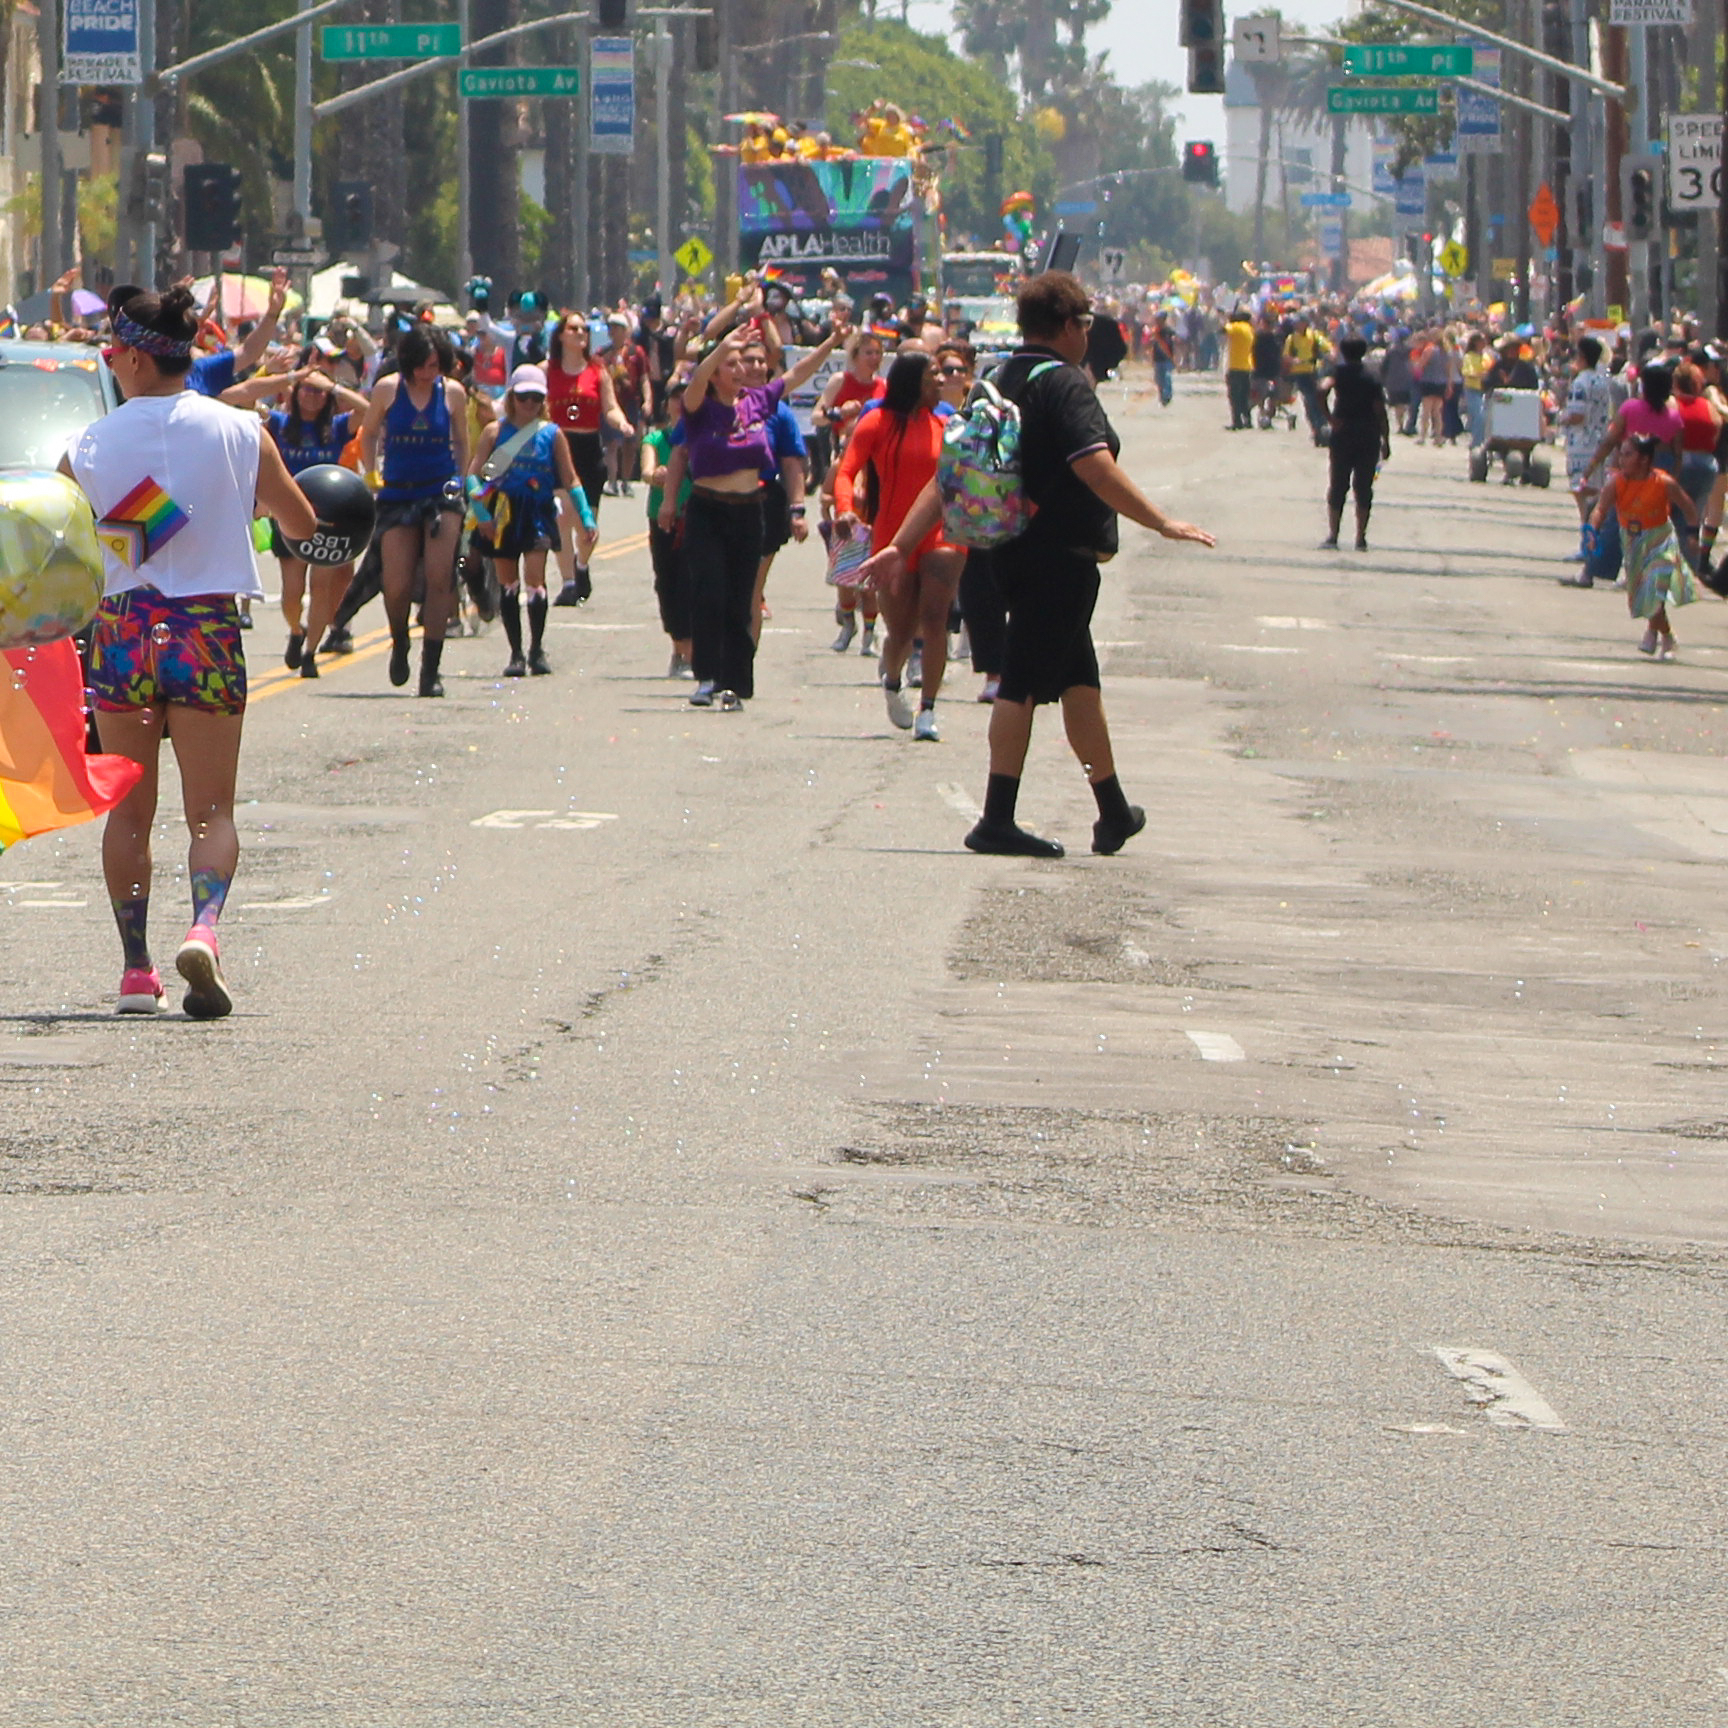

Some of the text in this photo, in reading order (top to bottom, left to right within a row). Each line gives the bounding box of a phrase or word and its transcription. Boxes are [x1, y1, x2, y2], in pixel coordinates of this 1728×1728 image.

[70, 15, 133, 31] PRIDE
[344, 31, 390, 53] 11th
[464, 73, 537, 92] Gaviota
[1675, 121, 1722, 137] SPEE
[1679, 144, 1721, 160] LIMI
[311, 532, 351, 549] LBS
[299, 541, 352, 562] 1000
